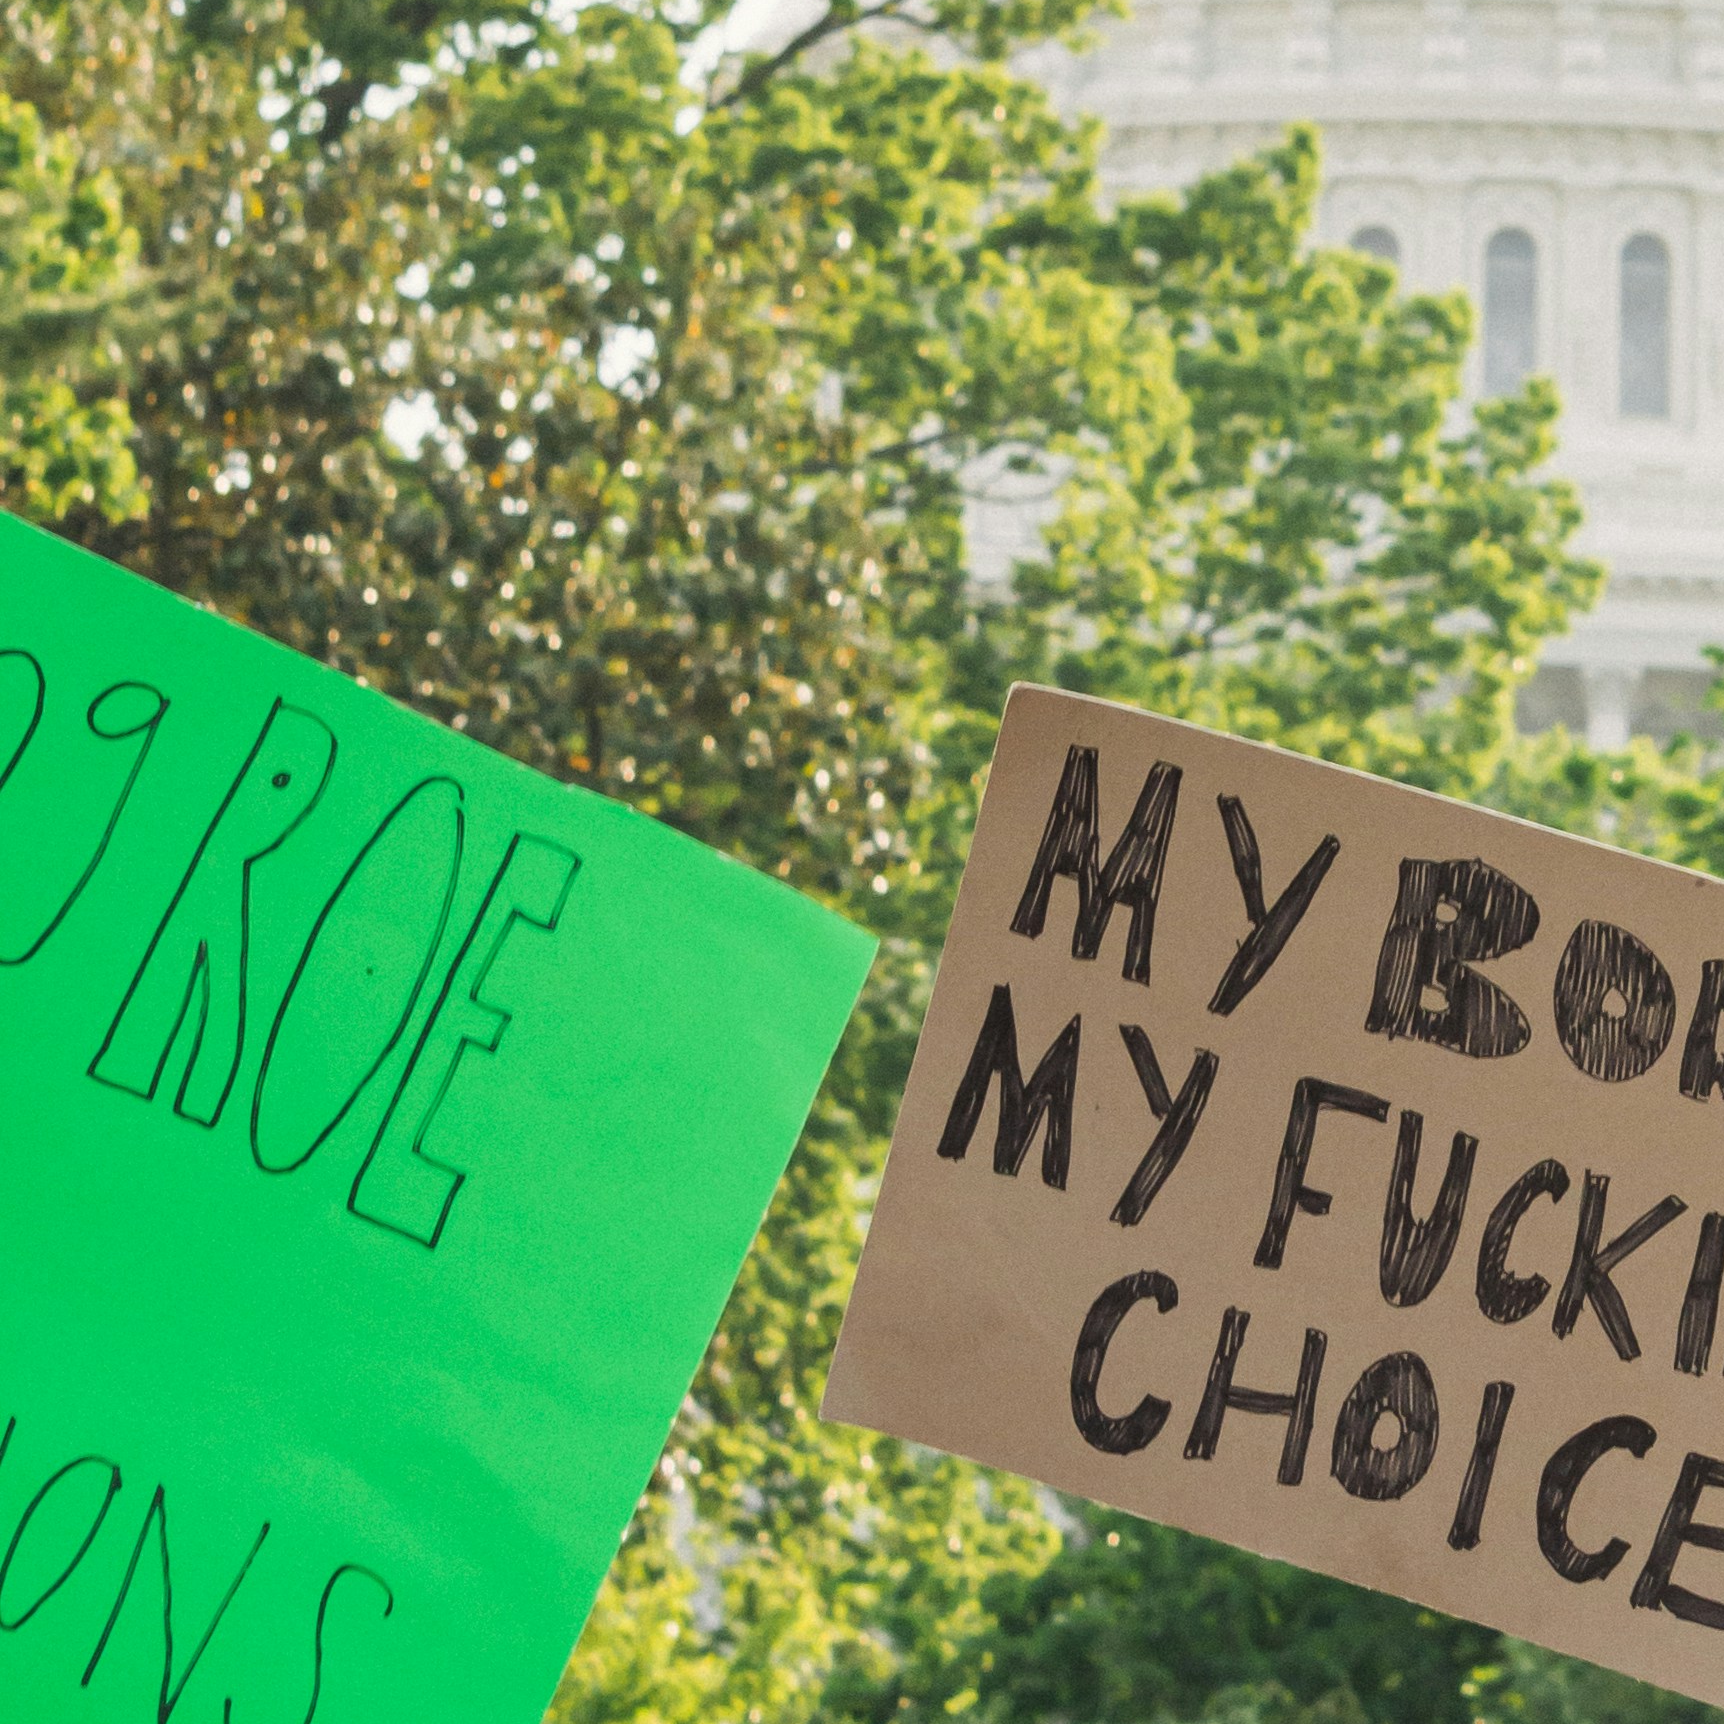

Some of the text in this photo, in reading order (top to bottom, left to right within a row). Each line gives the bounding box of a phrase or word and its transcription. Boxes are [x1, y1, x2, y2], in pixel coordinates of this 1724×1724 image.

[86, 696, 584, 1249] ROE
[1010, 743, 1342, 1018] MY
[936, 982, 1221, 1228] MY
